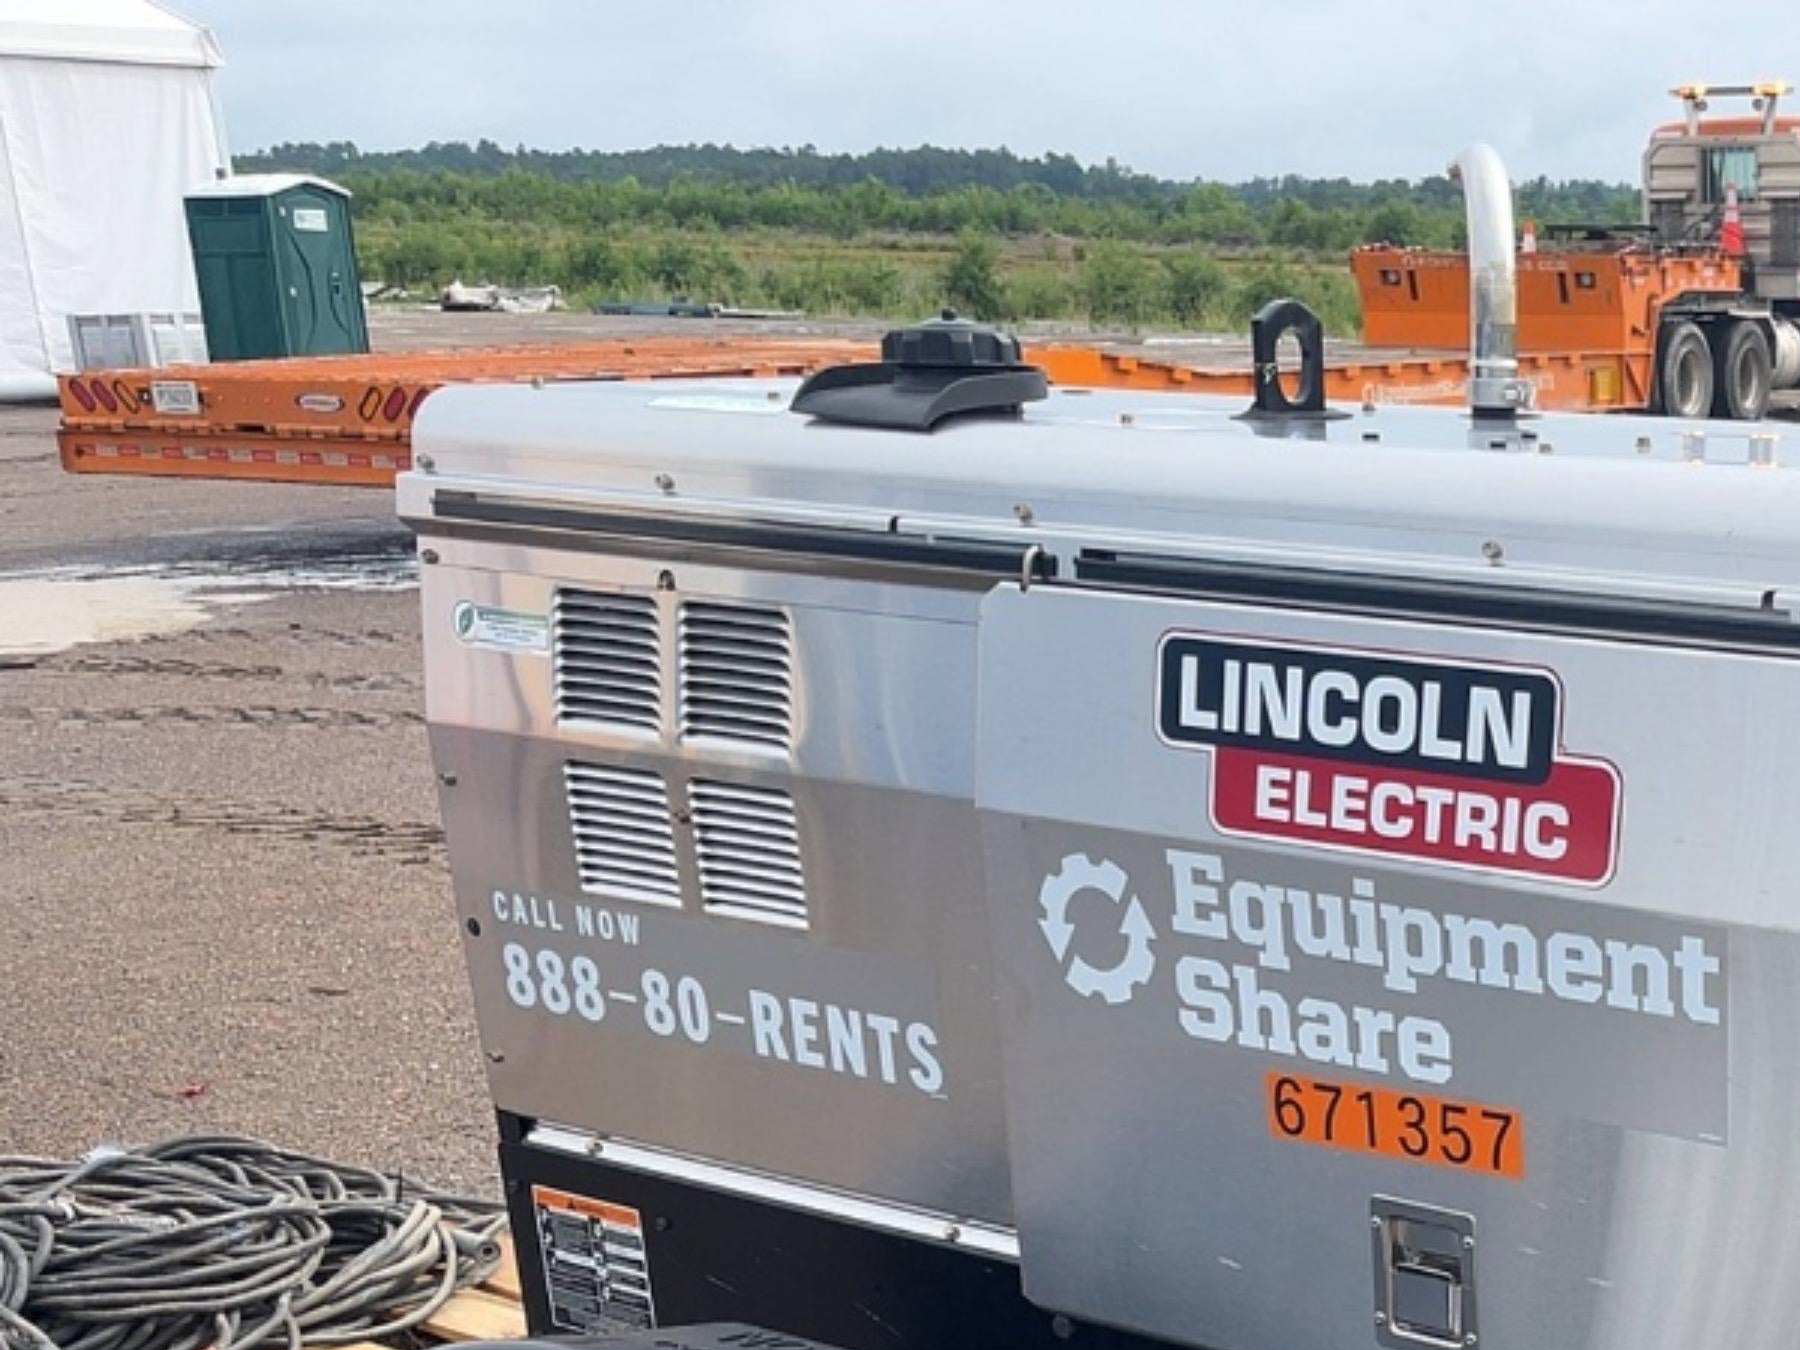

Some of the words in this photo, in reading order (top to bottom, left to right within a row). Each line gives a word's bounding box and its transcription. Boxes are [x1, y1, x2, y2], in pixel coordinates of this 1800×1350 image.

[1179, 655, 1531, 769] LINCOLN
[1255, 764, 1570, 860] ELECTRIC
[493, 890, 563, 931] CALL
[576, 904, 640, 945] NOW
[1165, 848, 1720, 1025] Equipment
[503, 942, 944, 1094] 888-80-RENTS
[1174, 956, 1453, 1085] Share
[1273, 1077, 1513, 1171] 671357
